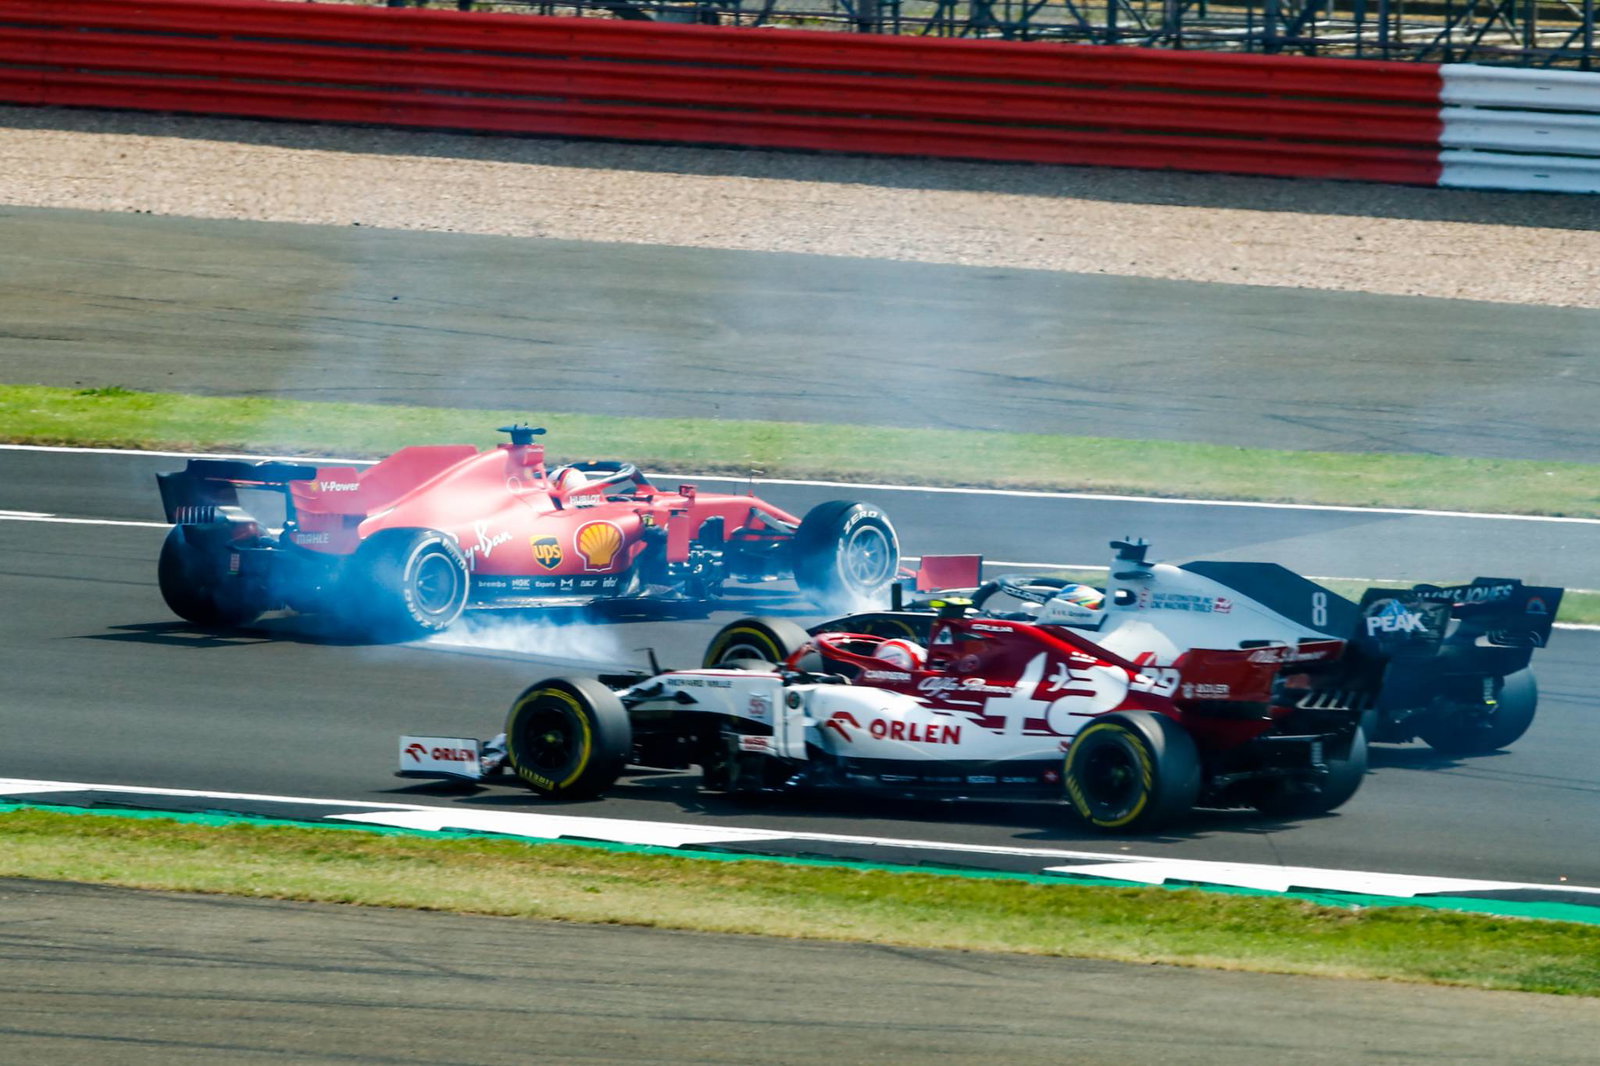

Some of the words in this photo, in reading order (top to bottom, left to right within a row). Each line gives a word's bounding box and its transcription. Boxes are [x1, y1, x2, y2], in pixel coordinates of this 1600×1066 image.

[320, 480, 360, 493] V-Power
[843, 510, 879, 535] ZERO
[296, 532, 329, 545] MAHLE
[534, 544, 562, 565] ups
[1311, 591, 1328, 627] 8
[1366, 612, 1428, 637] PEAK
[869, 718, 963, 745] ORLEN
[431, 748, 476, 762] ORLEN
